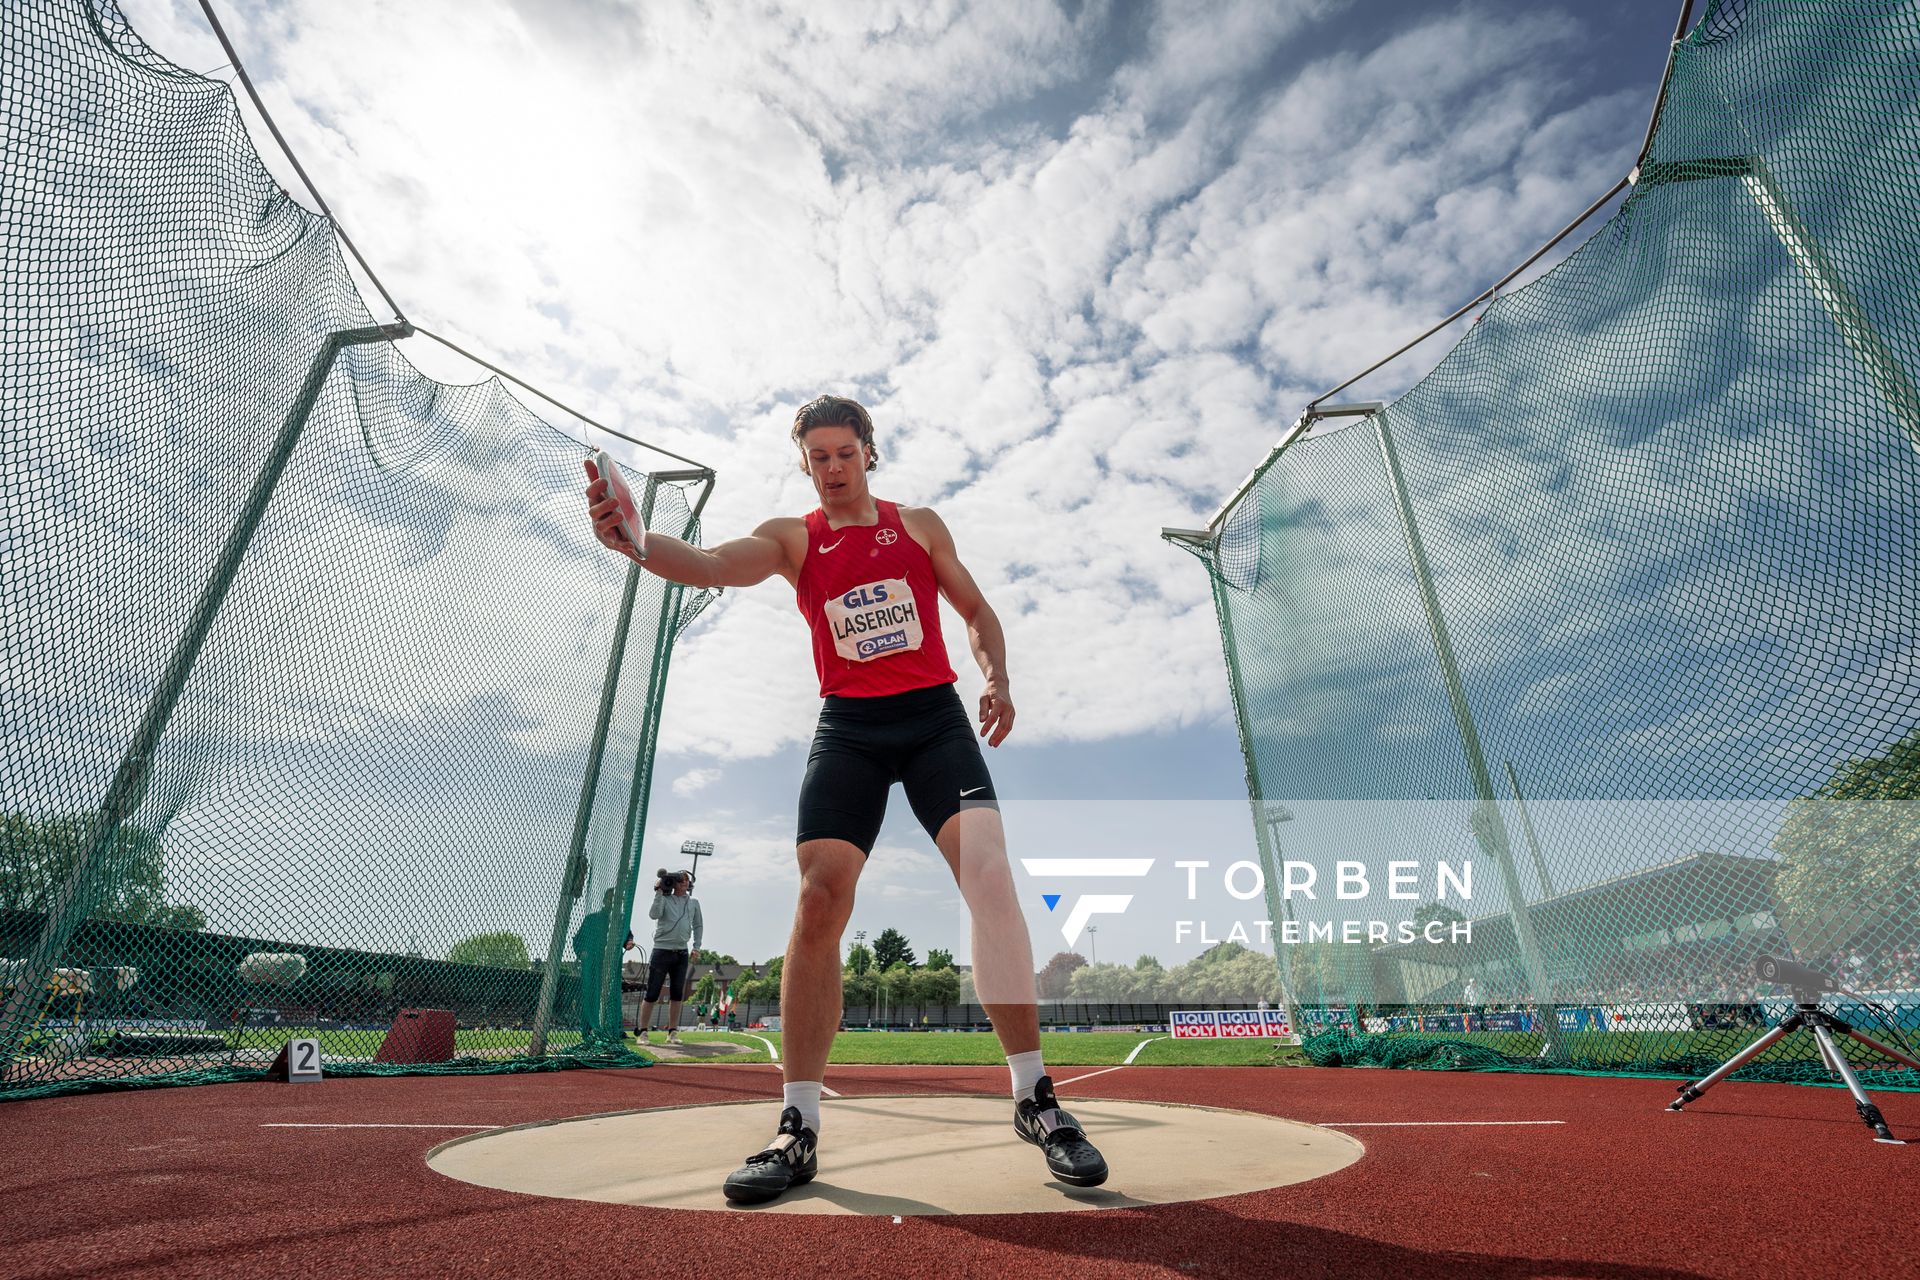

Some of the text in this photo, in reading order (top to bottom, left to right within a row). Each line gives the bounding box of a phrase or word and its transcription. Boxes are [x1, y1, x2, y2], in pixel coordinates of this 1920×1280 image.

[834, 602, 915, 640] LASERICH
[877, 633, 905, 647] PLAN
[1174, 1013, 1212, 1025] LIQUI
[1220, 1012, 1258, 1024] LIQUI
[1265, 1011, 1287, 1023] LIQ
[1176, 1024, 1215, 1036] MOLY
[1222, 1024, 1260, 1036] MOLY
[1267, 1024, 1291, 1036] MO
[297, 1042, 315, 1071] 2
